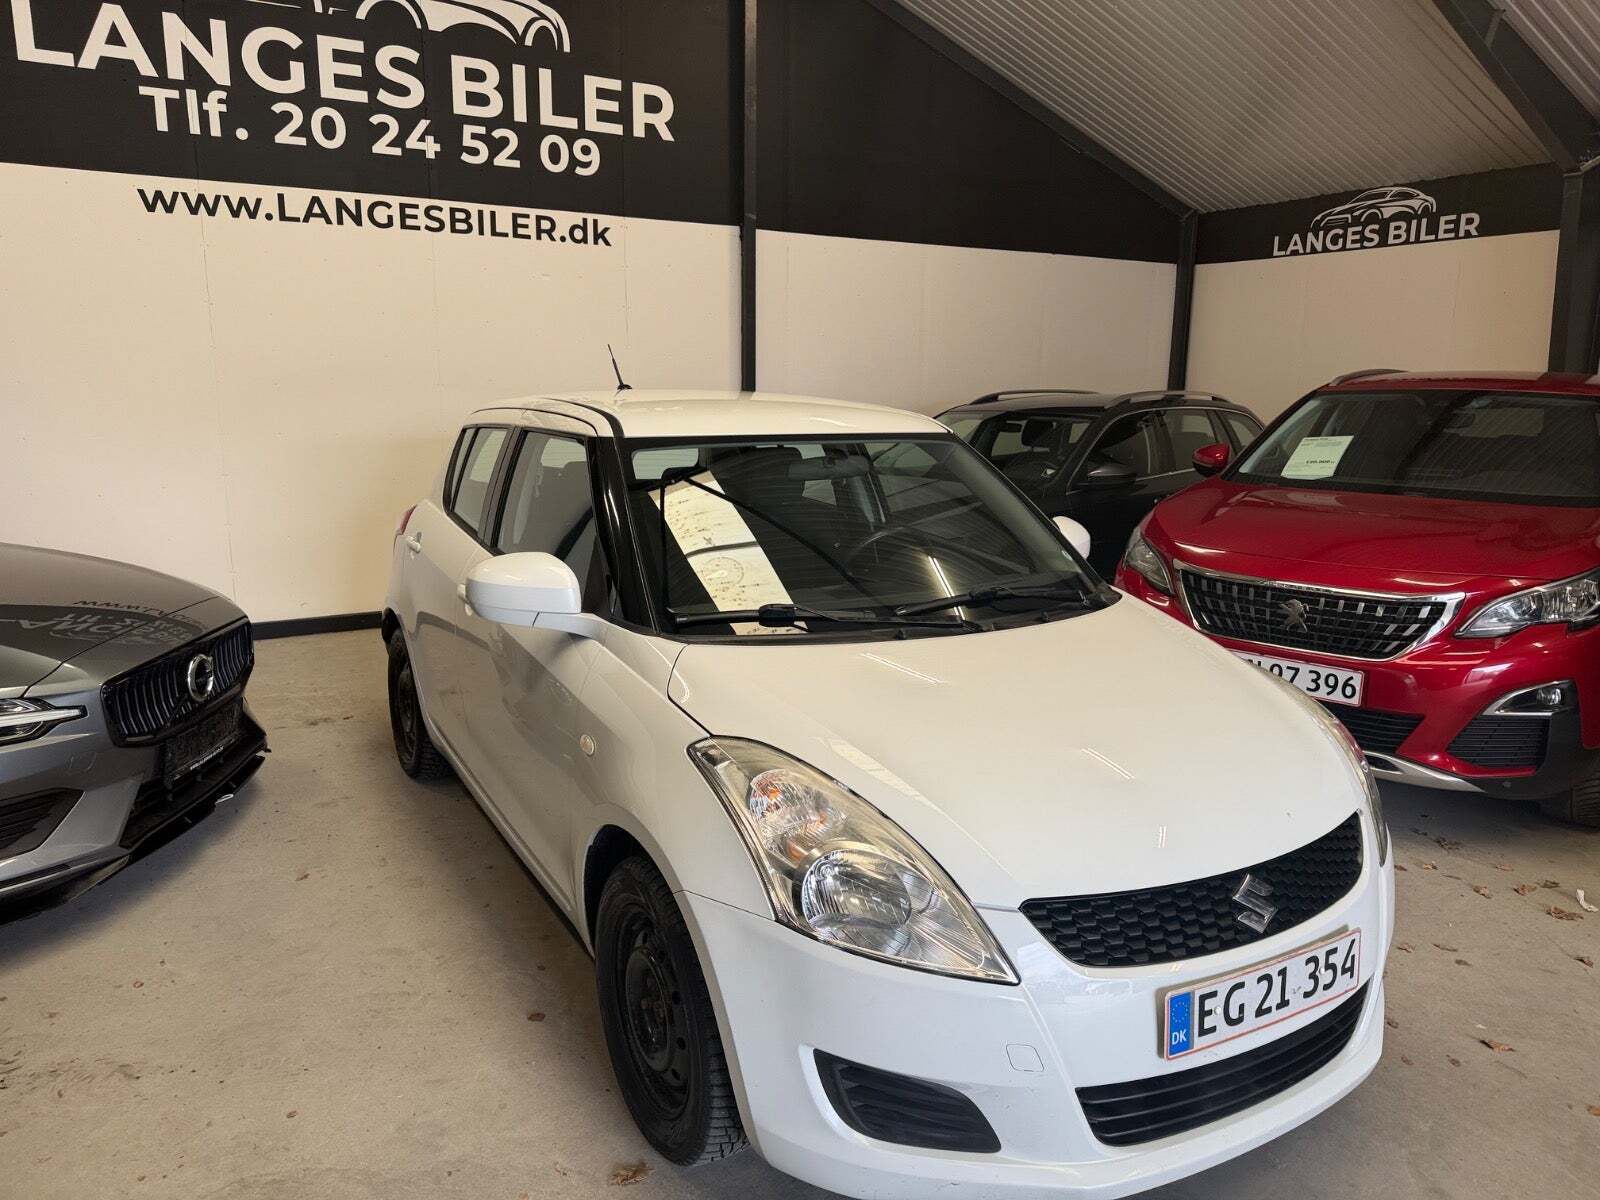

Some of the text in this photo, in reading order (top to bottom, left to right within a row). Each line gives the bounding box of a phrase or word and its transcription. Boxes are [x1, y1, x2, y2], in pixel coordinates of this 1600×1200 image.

[11, 0, 675, 142] LANGES BILER
[138, 85, 601, 176] Tlf. 20 24 52 09
[137, 188, 611, 247] www.LANGESBILER.dk
[1272, 212, 1481, 257] LANGES BILER
[1306, 670, 1356, 699] 396
[1198, 938, 1356, 1037] EG 21 354
[1171, 1031, 1187, 1045] DK
